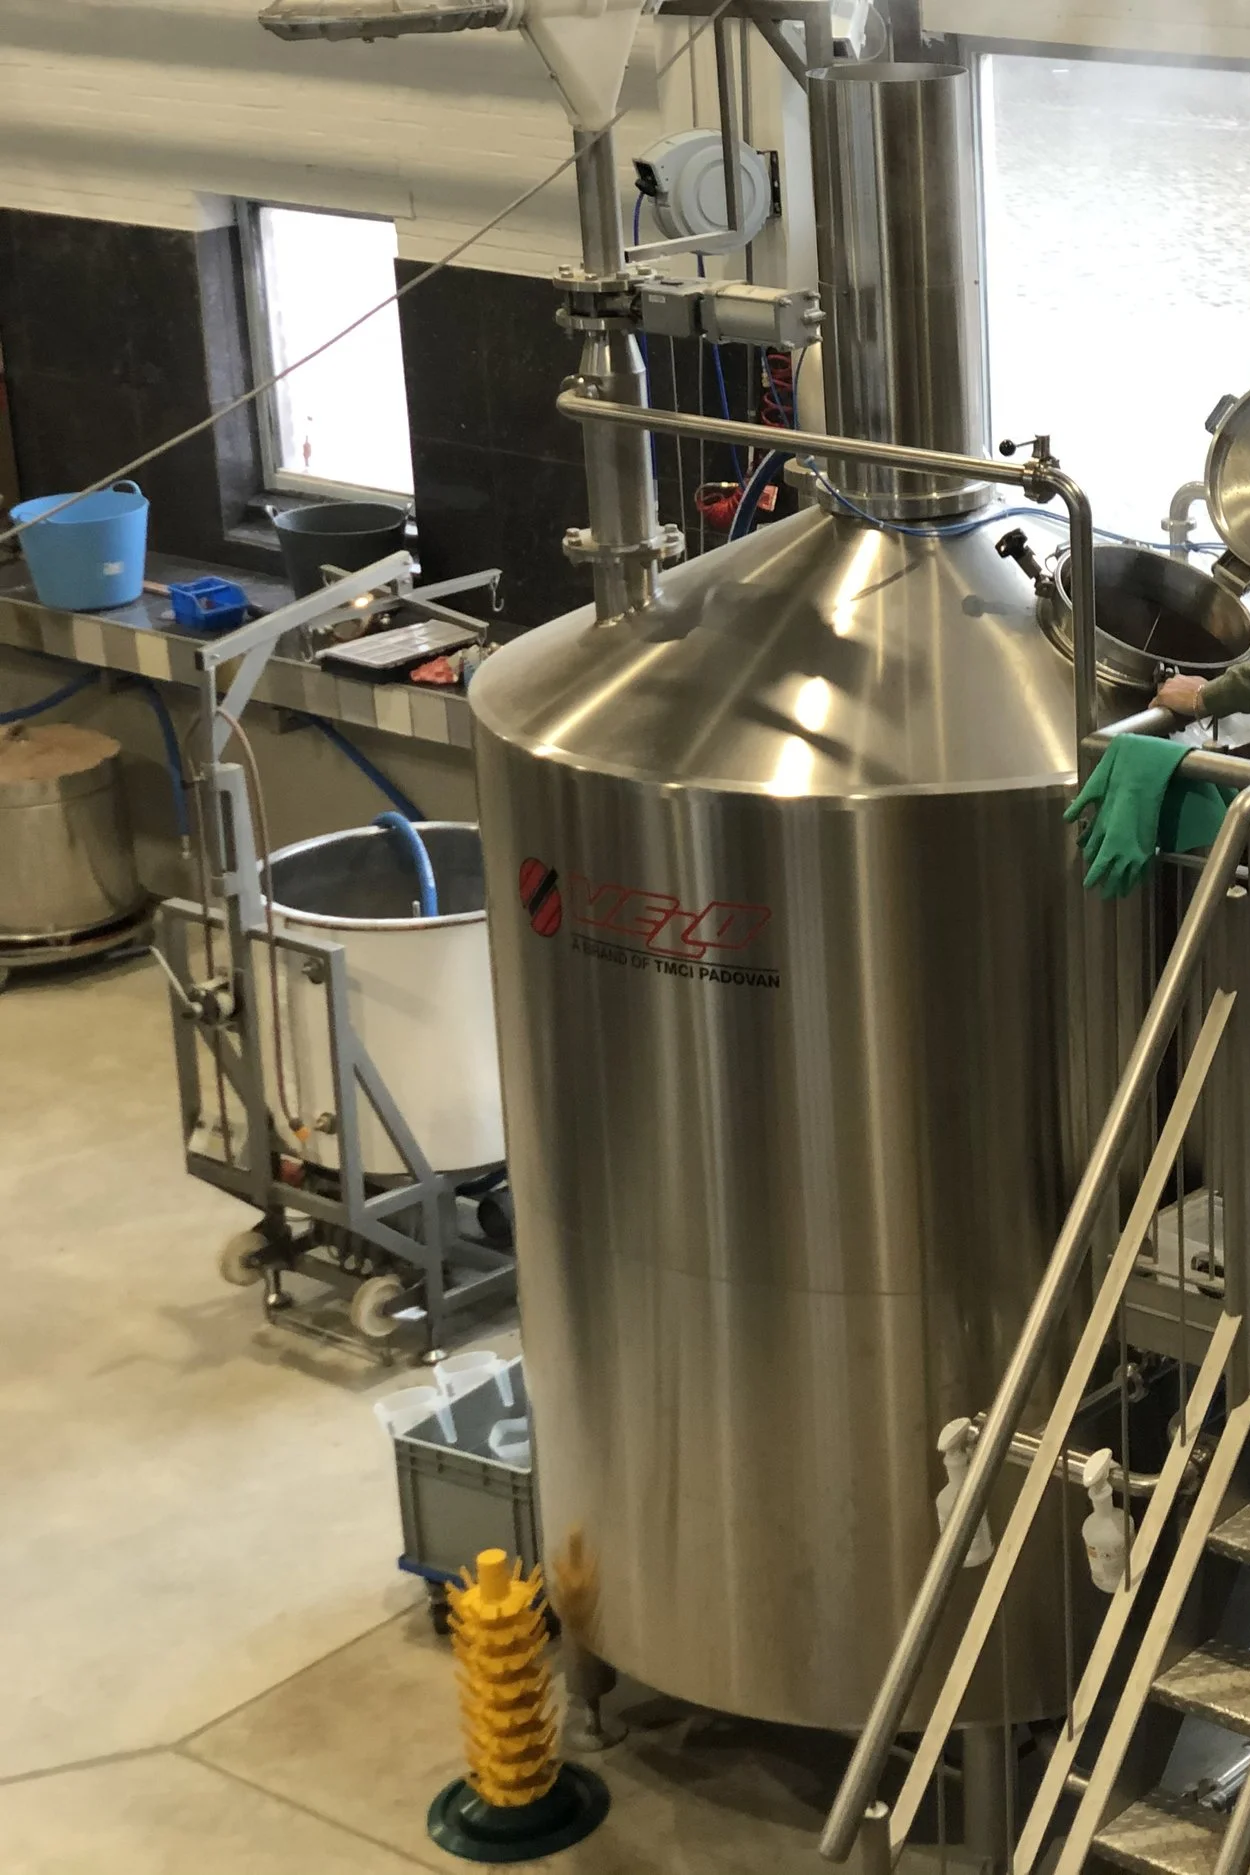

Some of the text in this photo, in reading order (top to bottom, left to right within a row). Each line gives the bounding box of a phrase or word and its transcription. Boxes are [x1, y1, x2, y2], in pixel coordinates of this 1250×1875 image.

[571, 938, 780, 988] A BRAND OF TMCI PADOVAN
